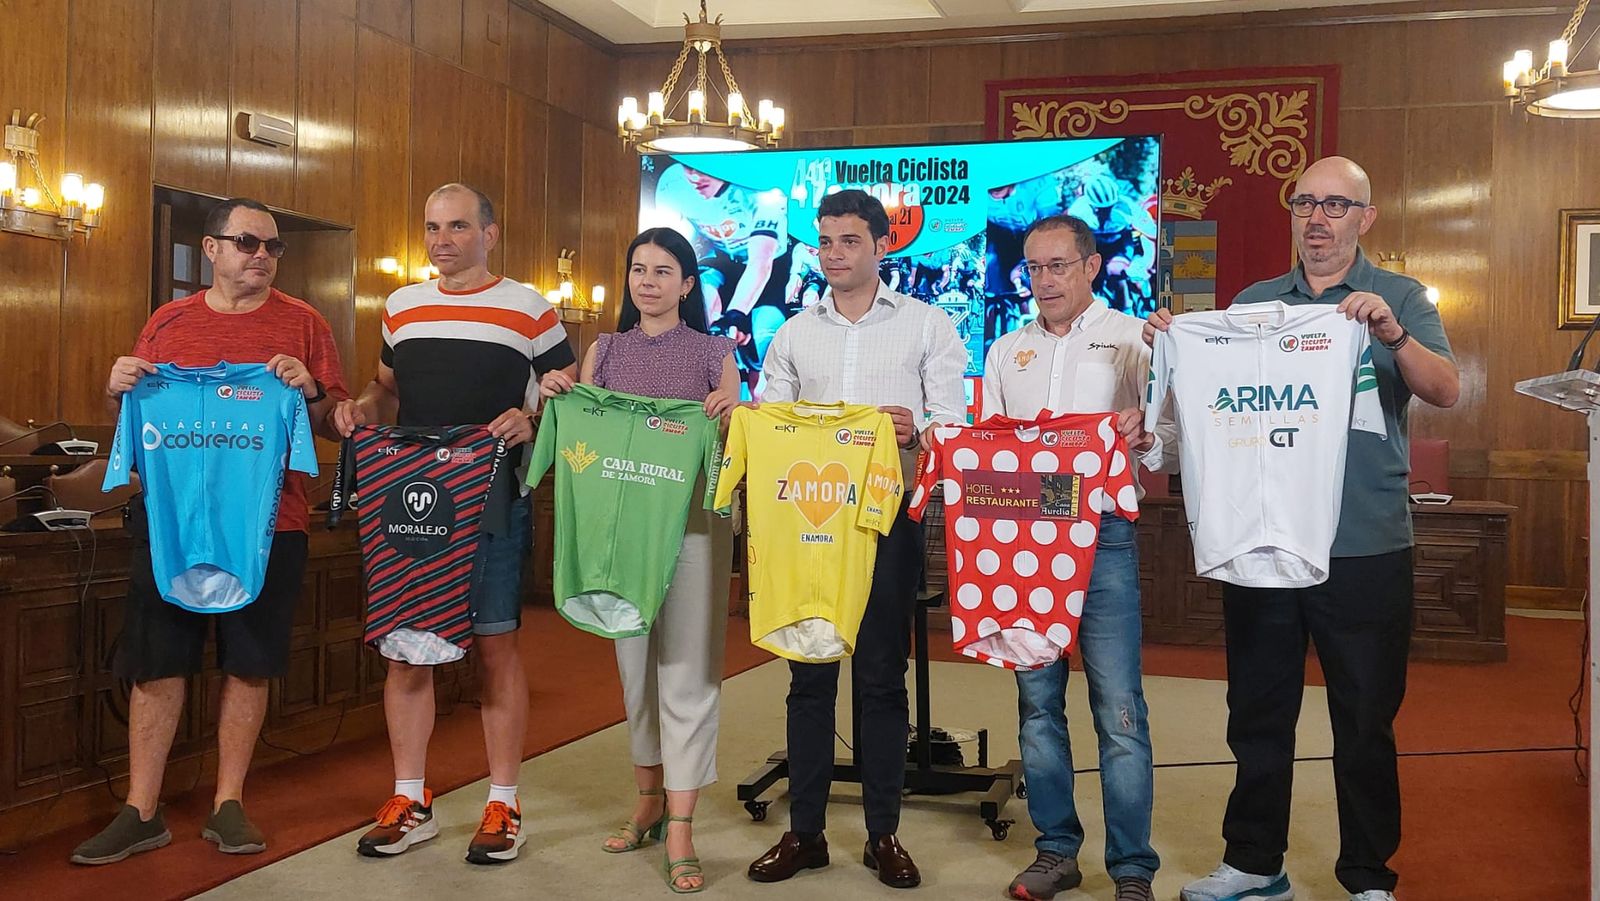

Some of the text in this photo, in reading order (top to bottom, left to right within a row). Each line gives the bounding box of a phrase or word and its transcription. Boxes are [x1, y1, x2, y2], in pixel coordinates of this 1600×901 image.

[836, 160, 893, 184] Vuelta
[898, 158, 968, 182] Ciclista
[922, 185, 970, 206] 2024
[900, 208, 912, 225] 21
[754, 220, 779, 230] BH
[1214, 414, 1319, 427] SEMILLAS
[163, 431, 264, 451] cobreros
[602, 470, 656, 485] DE ZAMORA
[603, 457, 685, 482] CAJA RURAL
[777, 480, 857, 505] ZAMORA
[866, 473, 900, 497] AMORA
[966, 484, 994, 494] HOTEL
[966, 496, 1039, 507] RESTAURANTE
[388, 524, 448, 535] MORALEJO
[801, 534, 833, 543] ENAMORA
